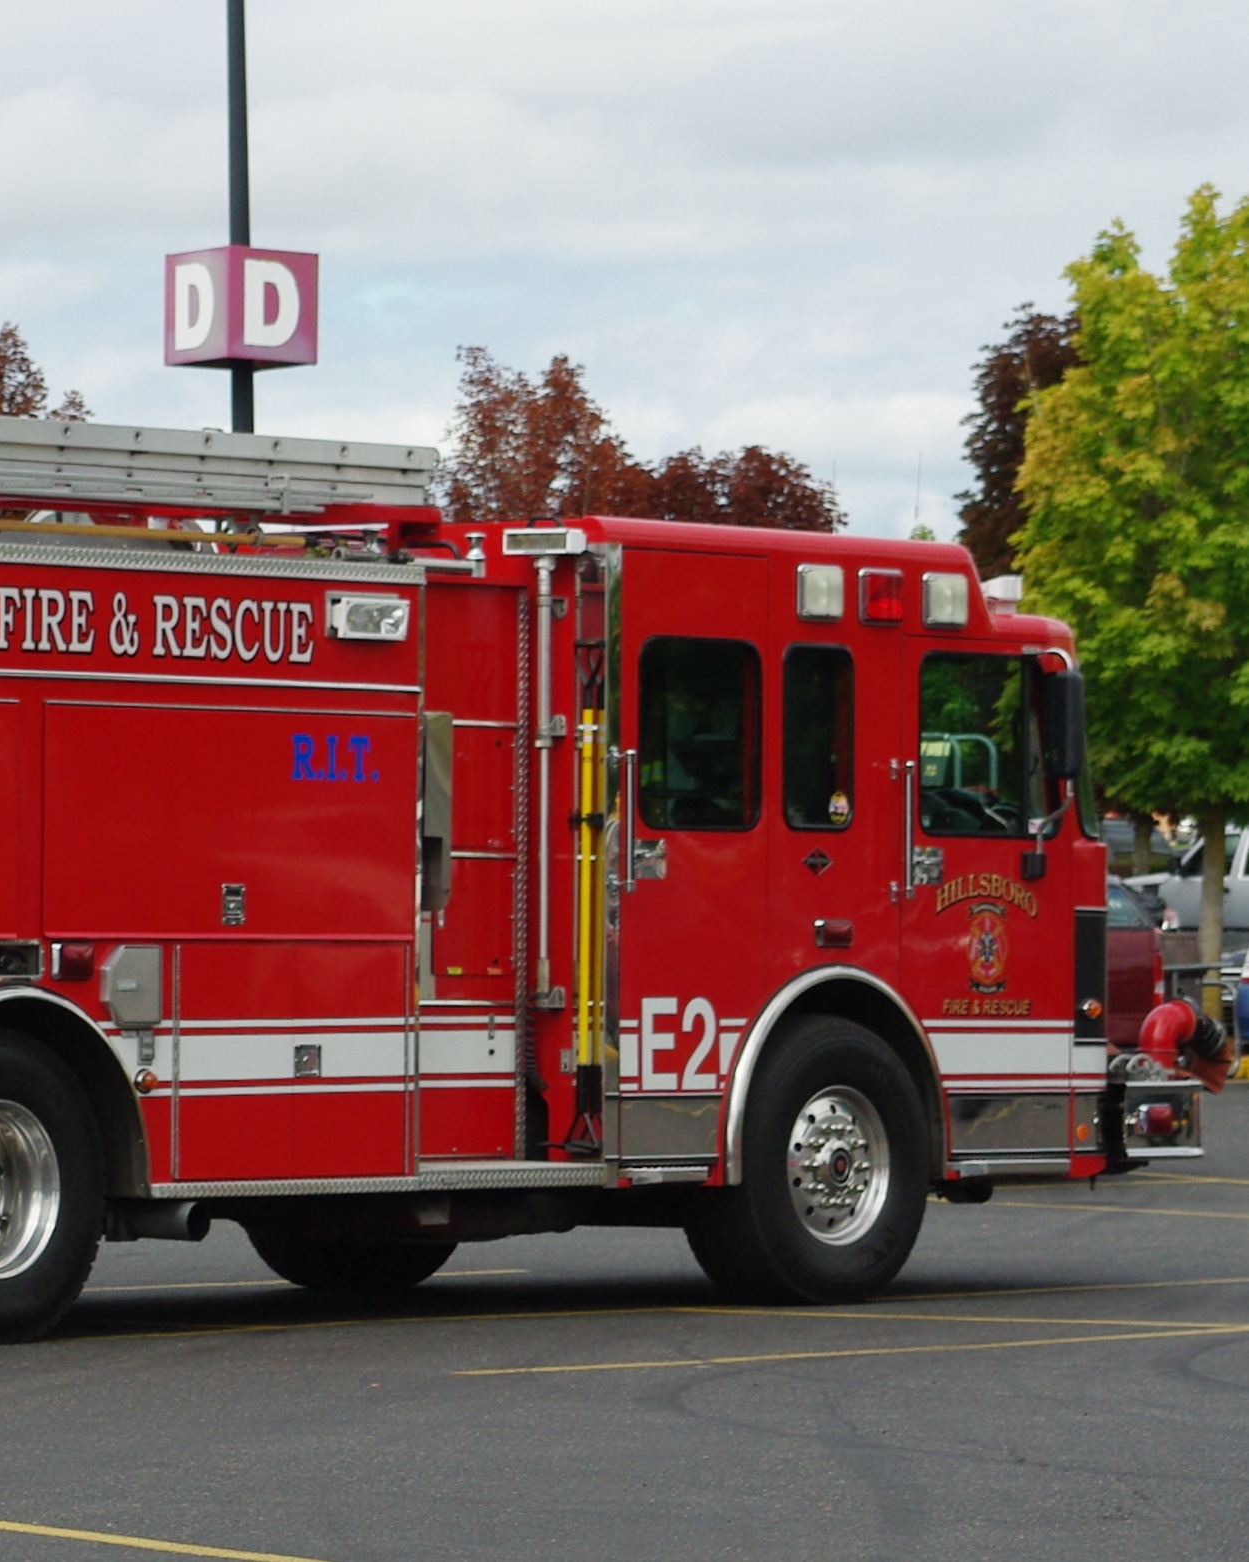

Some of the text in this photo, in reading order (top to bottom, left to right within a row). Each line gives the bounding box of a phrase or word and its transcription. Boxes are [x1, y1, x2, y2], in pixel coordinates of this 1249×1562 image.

[174, 263, 214, 351] D
[243, 259, 300, 347] D
[108, 591, 139, 657] &
[152, 594, 315, 664] RESCUE
[291, 733, 380, 783] R.I.T.
[936, 873, 1038, 918] HILLSBORO
[641, 997, 717, 1091] E2
[942, 999, 1031, 1016] FIRE & RESCUE
